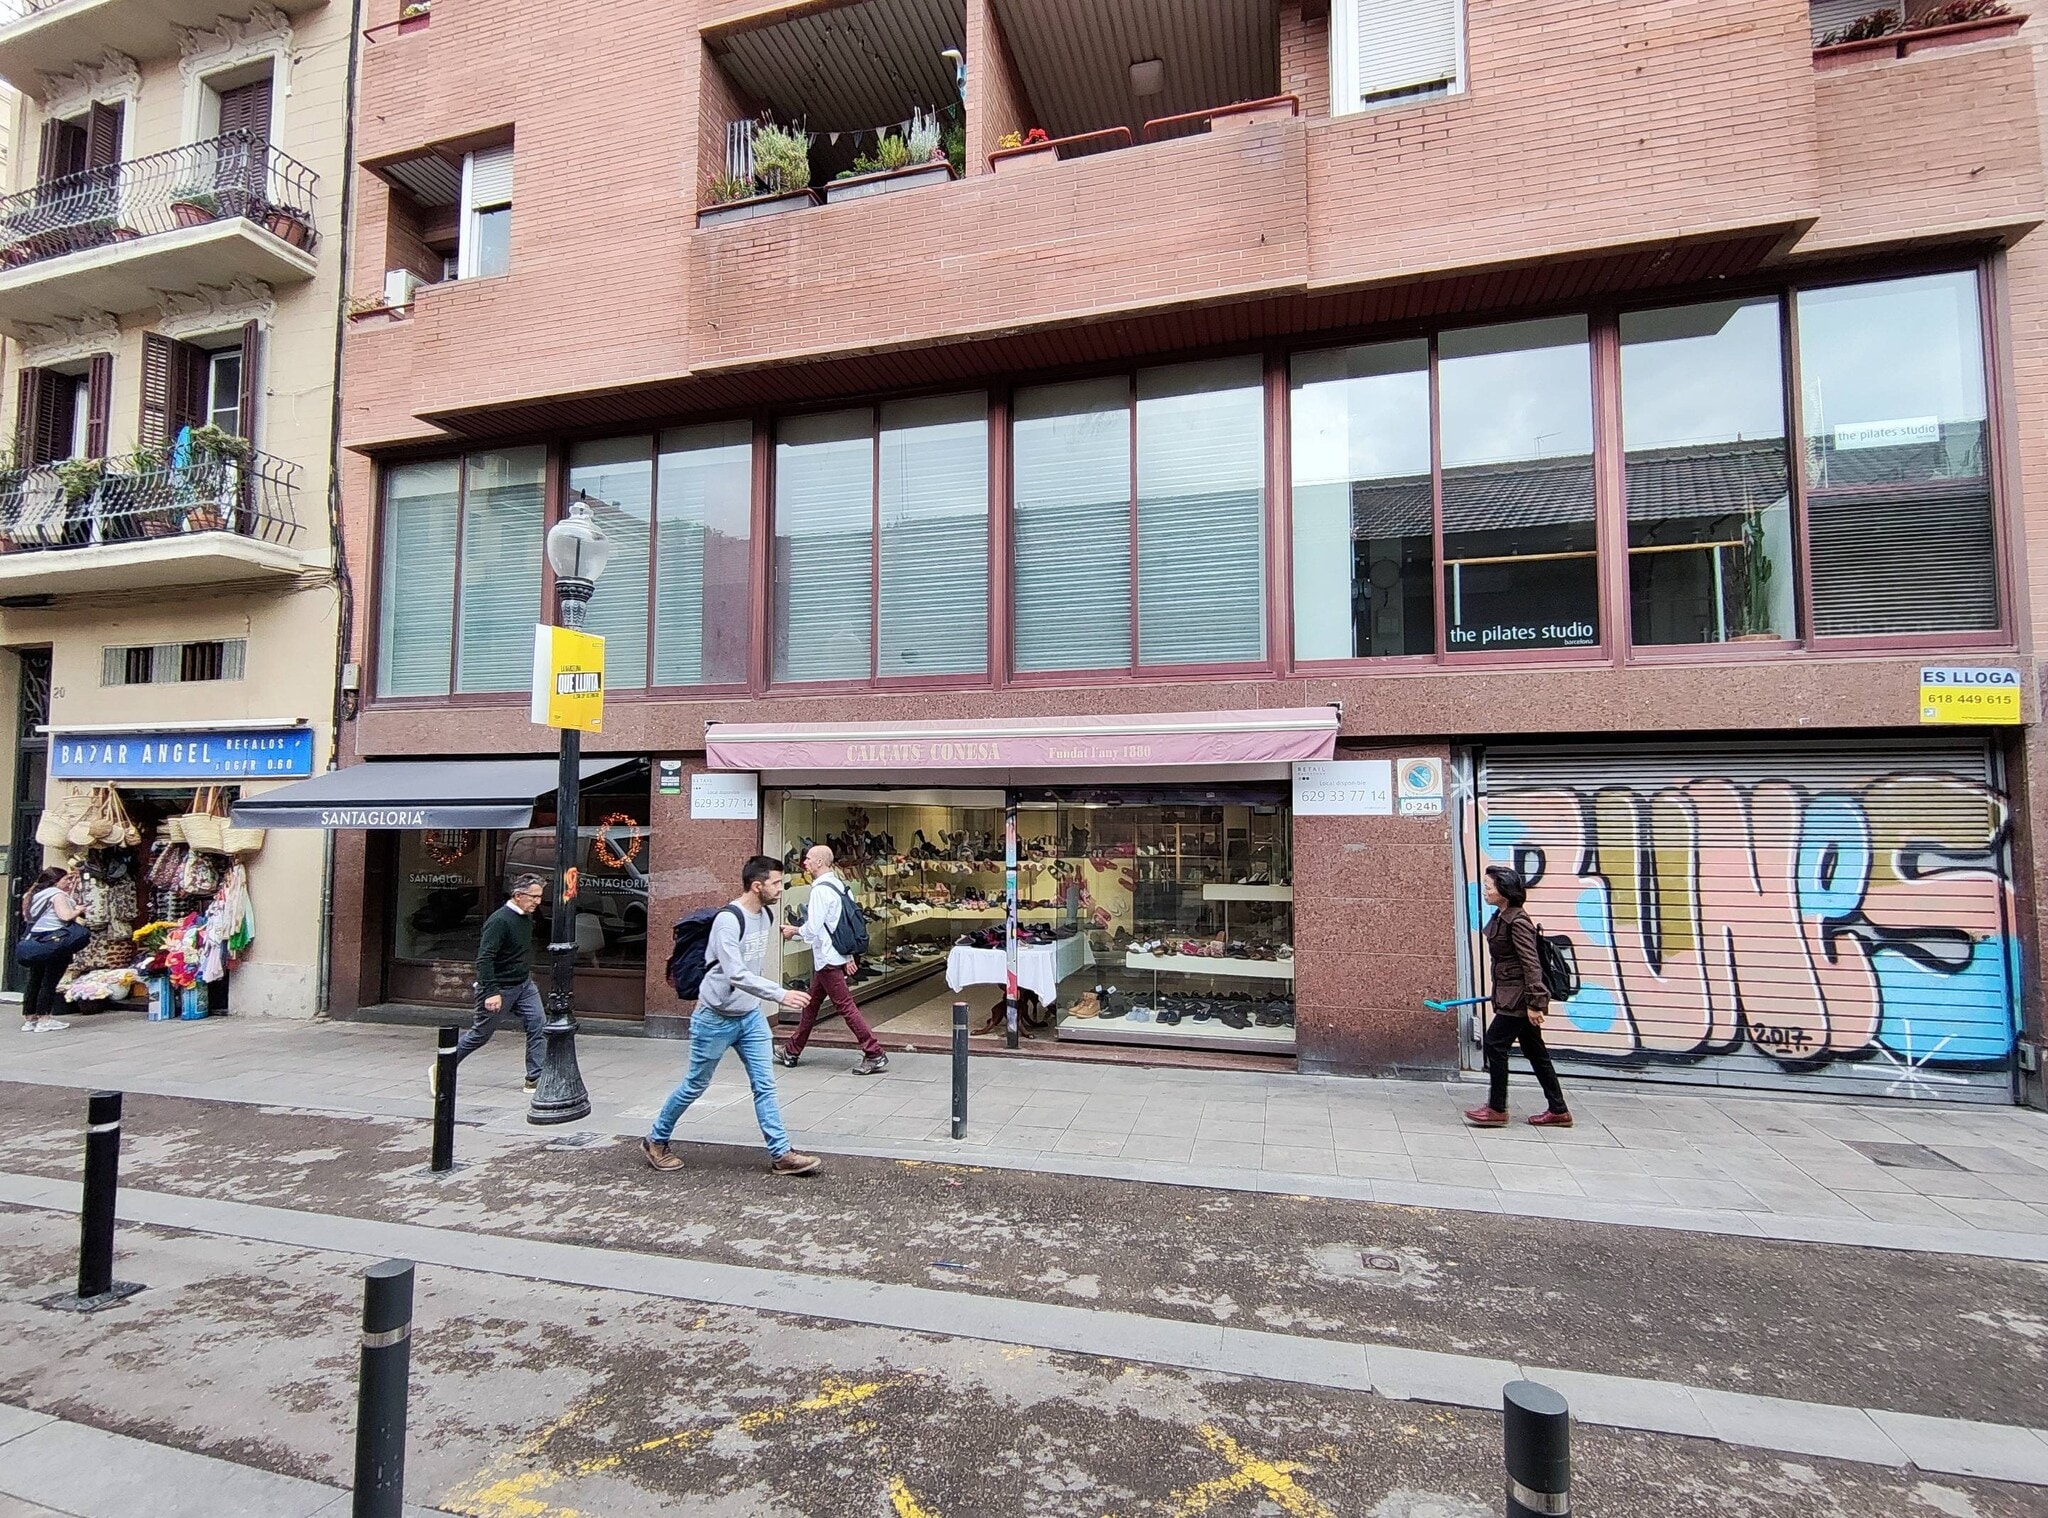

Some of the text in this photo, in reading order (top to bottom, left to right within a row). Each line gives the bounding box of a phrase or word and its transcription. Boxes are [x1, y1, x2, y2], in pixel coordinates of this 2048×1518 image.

[1838, 424, 1936, 441] the pilates studio
[1450, 621, 1593, 645] the pilates studio
[1564, 638, 1594, 646] barcelona
[1923, 671, 2016, 684] ES LLOGA
[53, 687, 66, 699] 20
[1928, 694, 2012, 705] 618 449 615
[142, 743, 211, 764] ANGEL
[846, 742, 1001, 766] CALÇATS CONESA
[1048, 746, 1088, 759] Fundat
[1123, 744, 1152, 758] 1880
[1301, 790, 1386, 802] 629 33 77 14
[694, 798, 753, 808] 629 33 77 14
[321, 810, 423, 825] SANTAGLORIA
[579, 877, 650, 888] SANTAGLORIA
